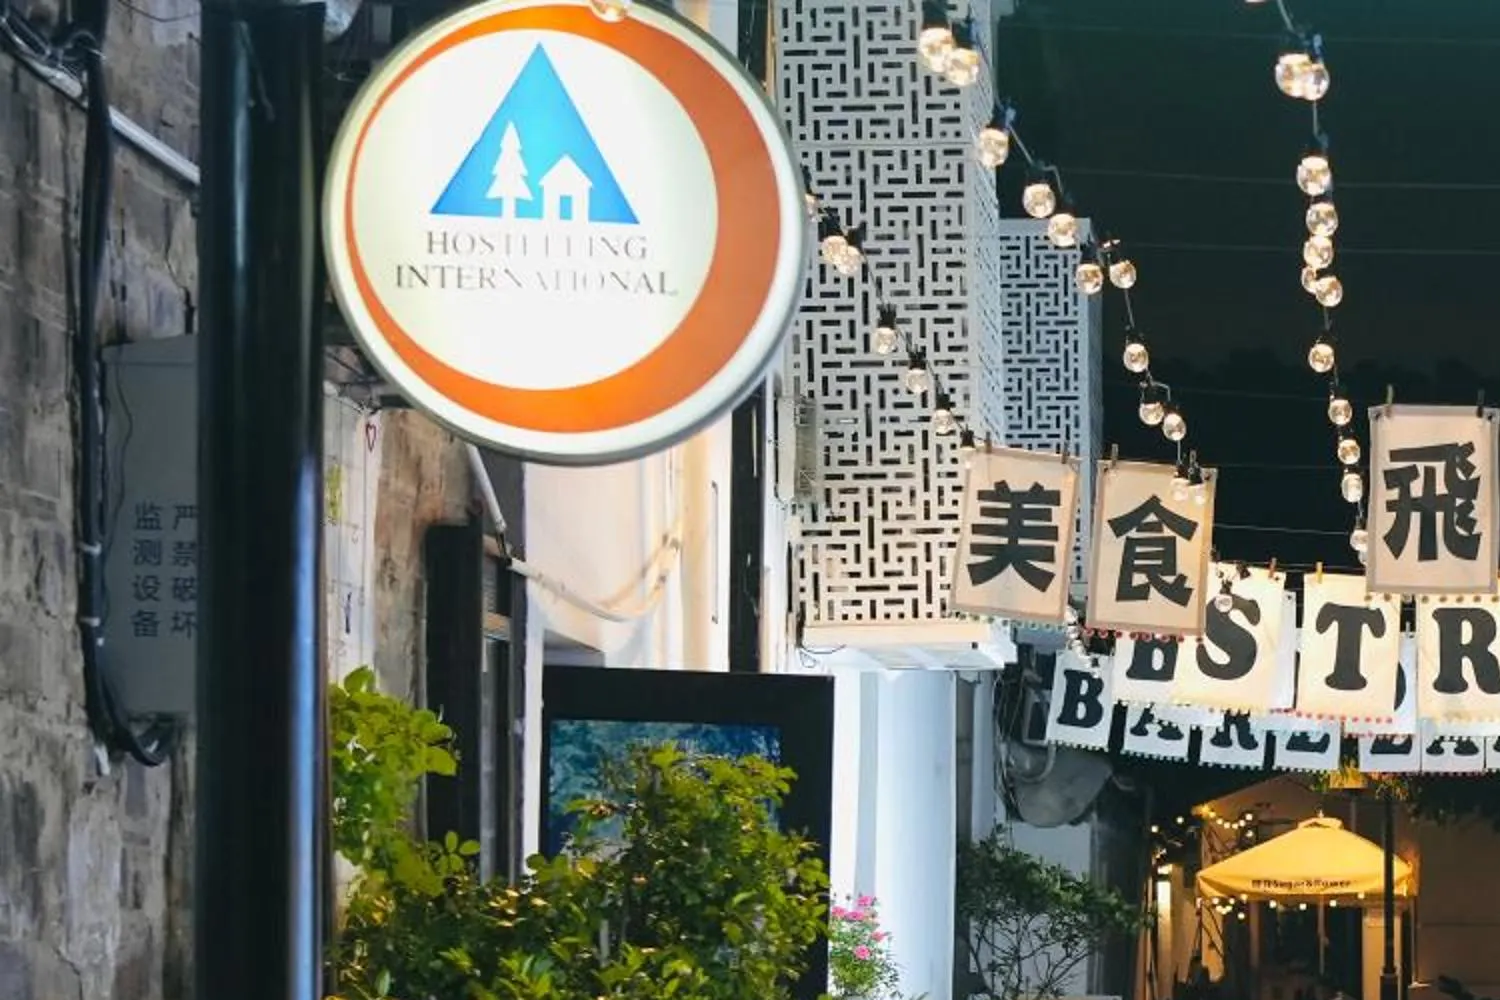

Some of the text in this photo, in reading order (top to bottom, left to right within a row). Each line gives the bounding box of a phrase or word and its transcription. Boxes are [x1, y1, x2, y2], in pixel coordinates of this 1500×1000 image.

[394, 263, 681, 297] INTERNATIONAL
[131, 501, 163, 638] 监测设备
[966, 479, 1199, 608] 美食
